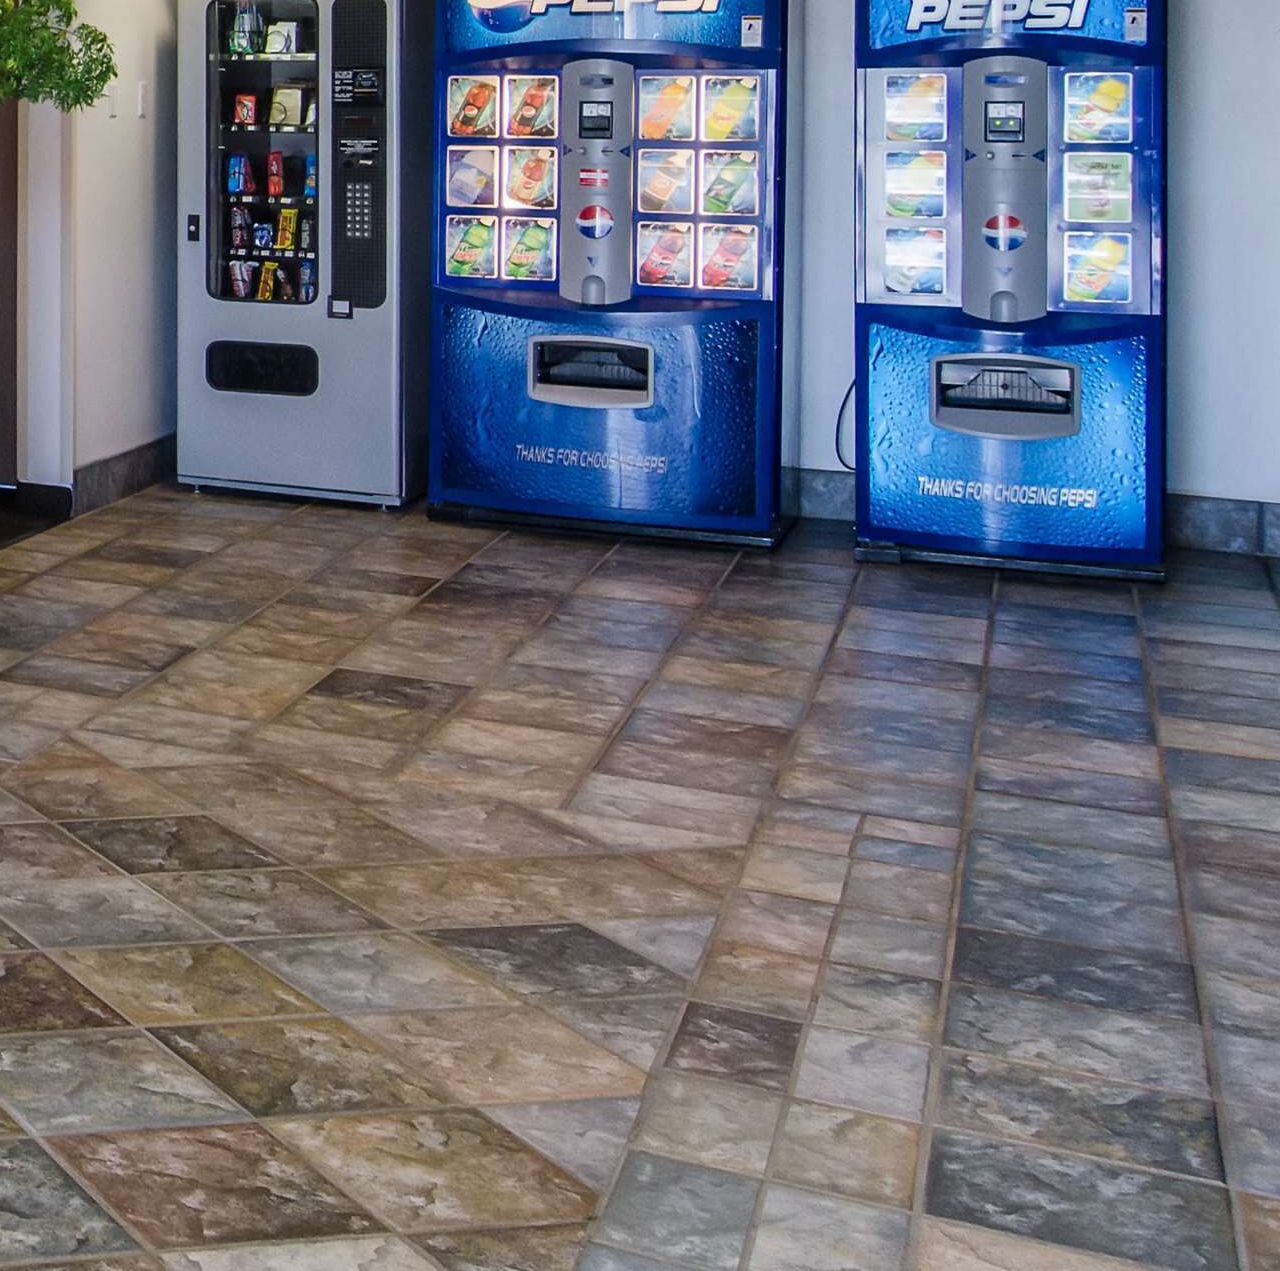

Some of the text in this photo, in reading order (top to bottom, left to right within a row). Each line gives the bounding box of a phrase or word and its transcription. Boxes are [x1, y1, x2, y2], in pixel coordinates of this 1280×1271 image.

[515, 445, 555, 464] THANKS
[556, 448, 578, 466] FOR
[580, 451, 638, 472] CHOO
[917, 476, 1097, 509] THANKS FOR CHOOSING PEPSI
